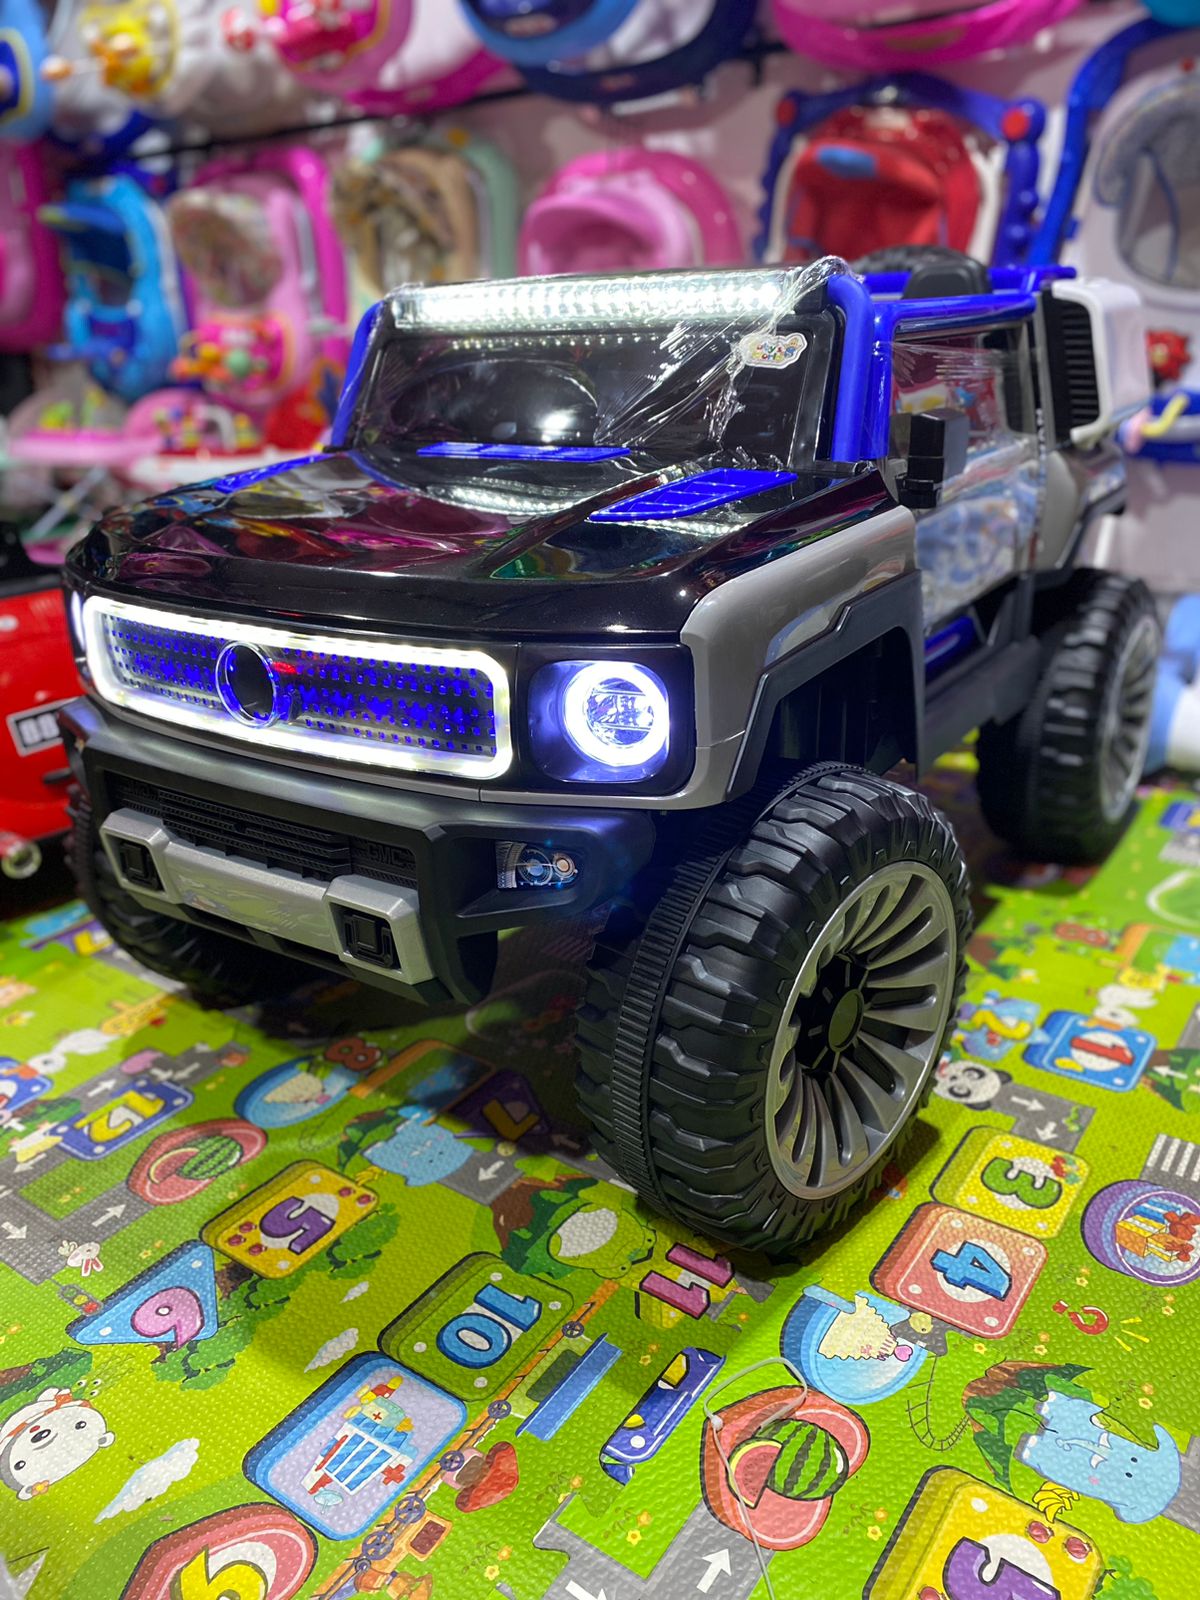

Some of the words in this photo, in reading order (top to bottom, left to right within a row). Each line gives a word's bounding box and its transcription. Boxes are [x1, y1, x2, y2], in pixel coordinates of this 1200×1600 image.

[324, 1037, 382, 1071] 8
[1070, 1036, 1134, 1065] 1
[73, 1090, 166, 1143] 12
[981, 1156, 1062, 1209] 3
[260, 1196, 335, 1254] 5
[639, 1242, 735, 1320] 11
[930, 1241, 1012, 1301] 4
[436, 1283, 543, 1369] 10
